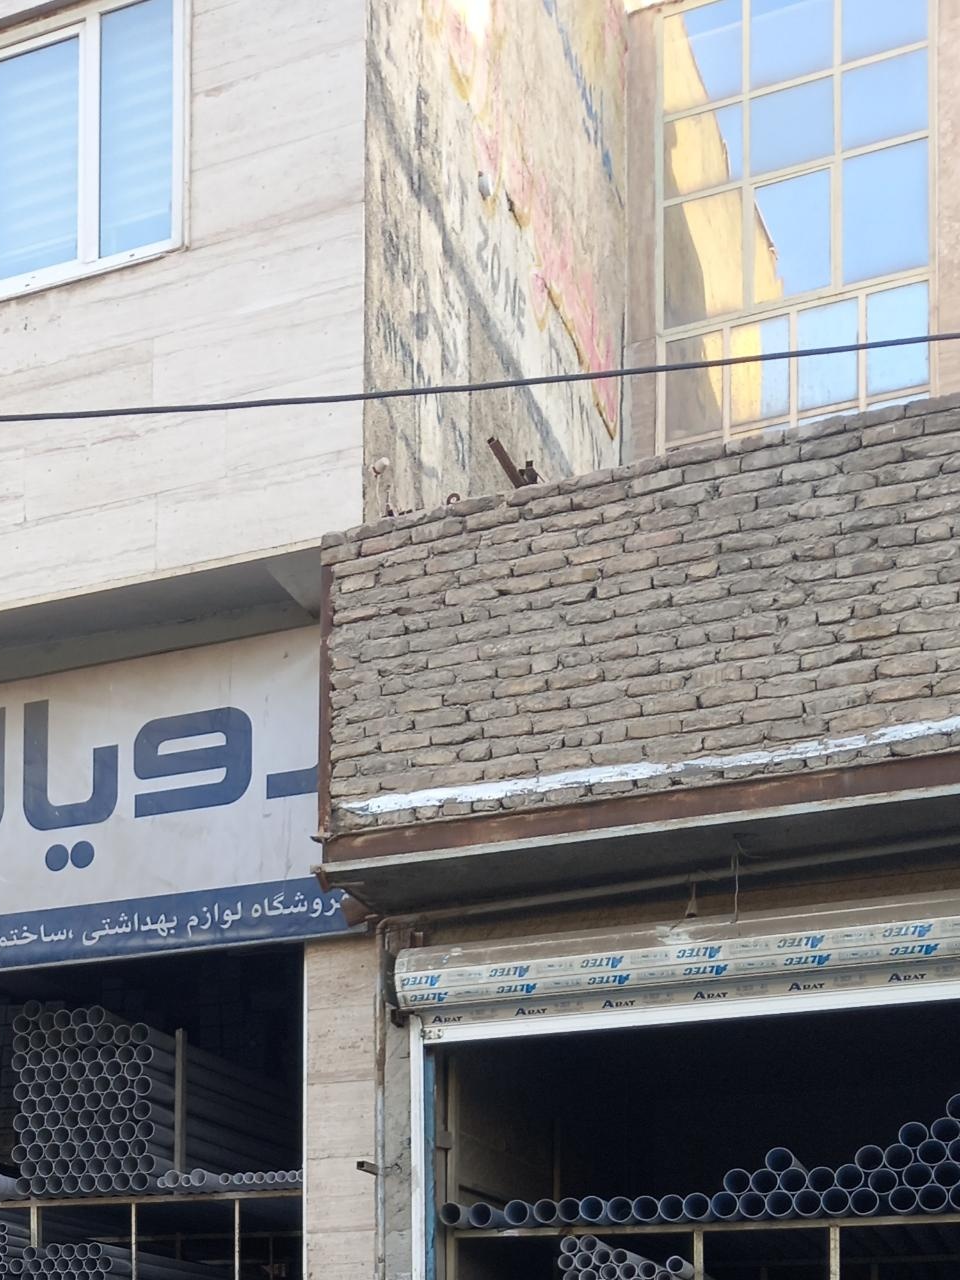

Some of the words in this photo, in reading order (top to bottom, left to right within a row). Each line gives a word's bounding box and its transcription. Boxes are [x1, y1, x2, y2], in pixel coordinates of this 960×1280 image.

[82, 912, 178, 947] بهداشتی
[187, 901, 242, 938] لوازم
[401, 973, 442, 988] ALTEC
[490, 965, 530, 978] ALTEC
[580, 955, 625, 969] ALTEC
[677, 944, 723, 960] ALTEC
[777, 934, 827, 949] ALTEC
[882, 923, 934, 938] ALTEC
[410, 991, 448, 1003] ALTEC
[496, 982, 537, 995] ALTEC
[588, 973, 631, 985] ALTEC
[683, 963, 729, 976] ALTEC
[784, 953, 832, 967] ALTEC
[889, 942, 940, 956] ALTEC
